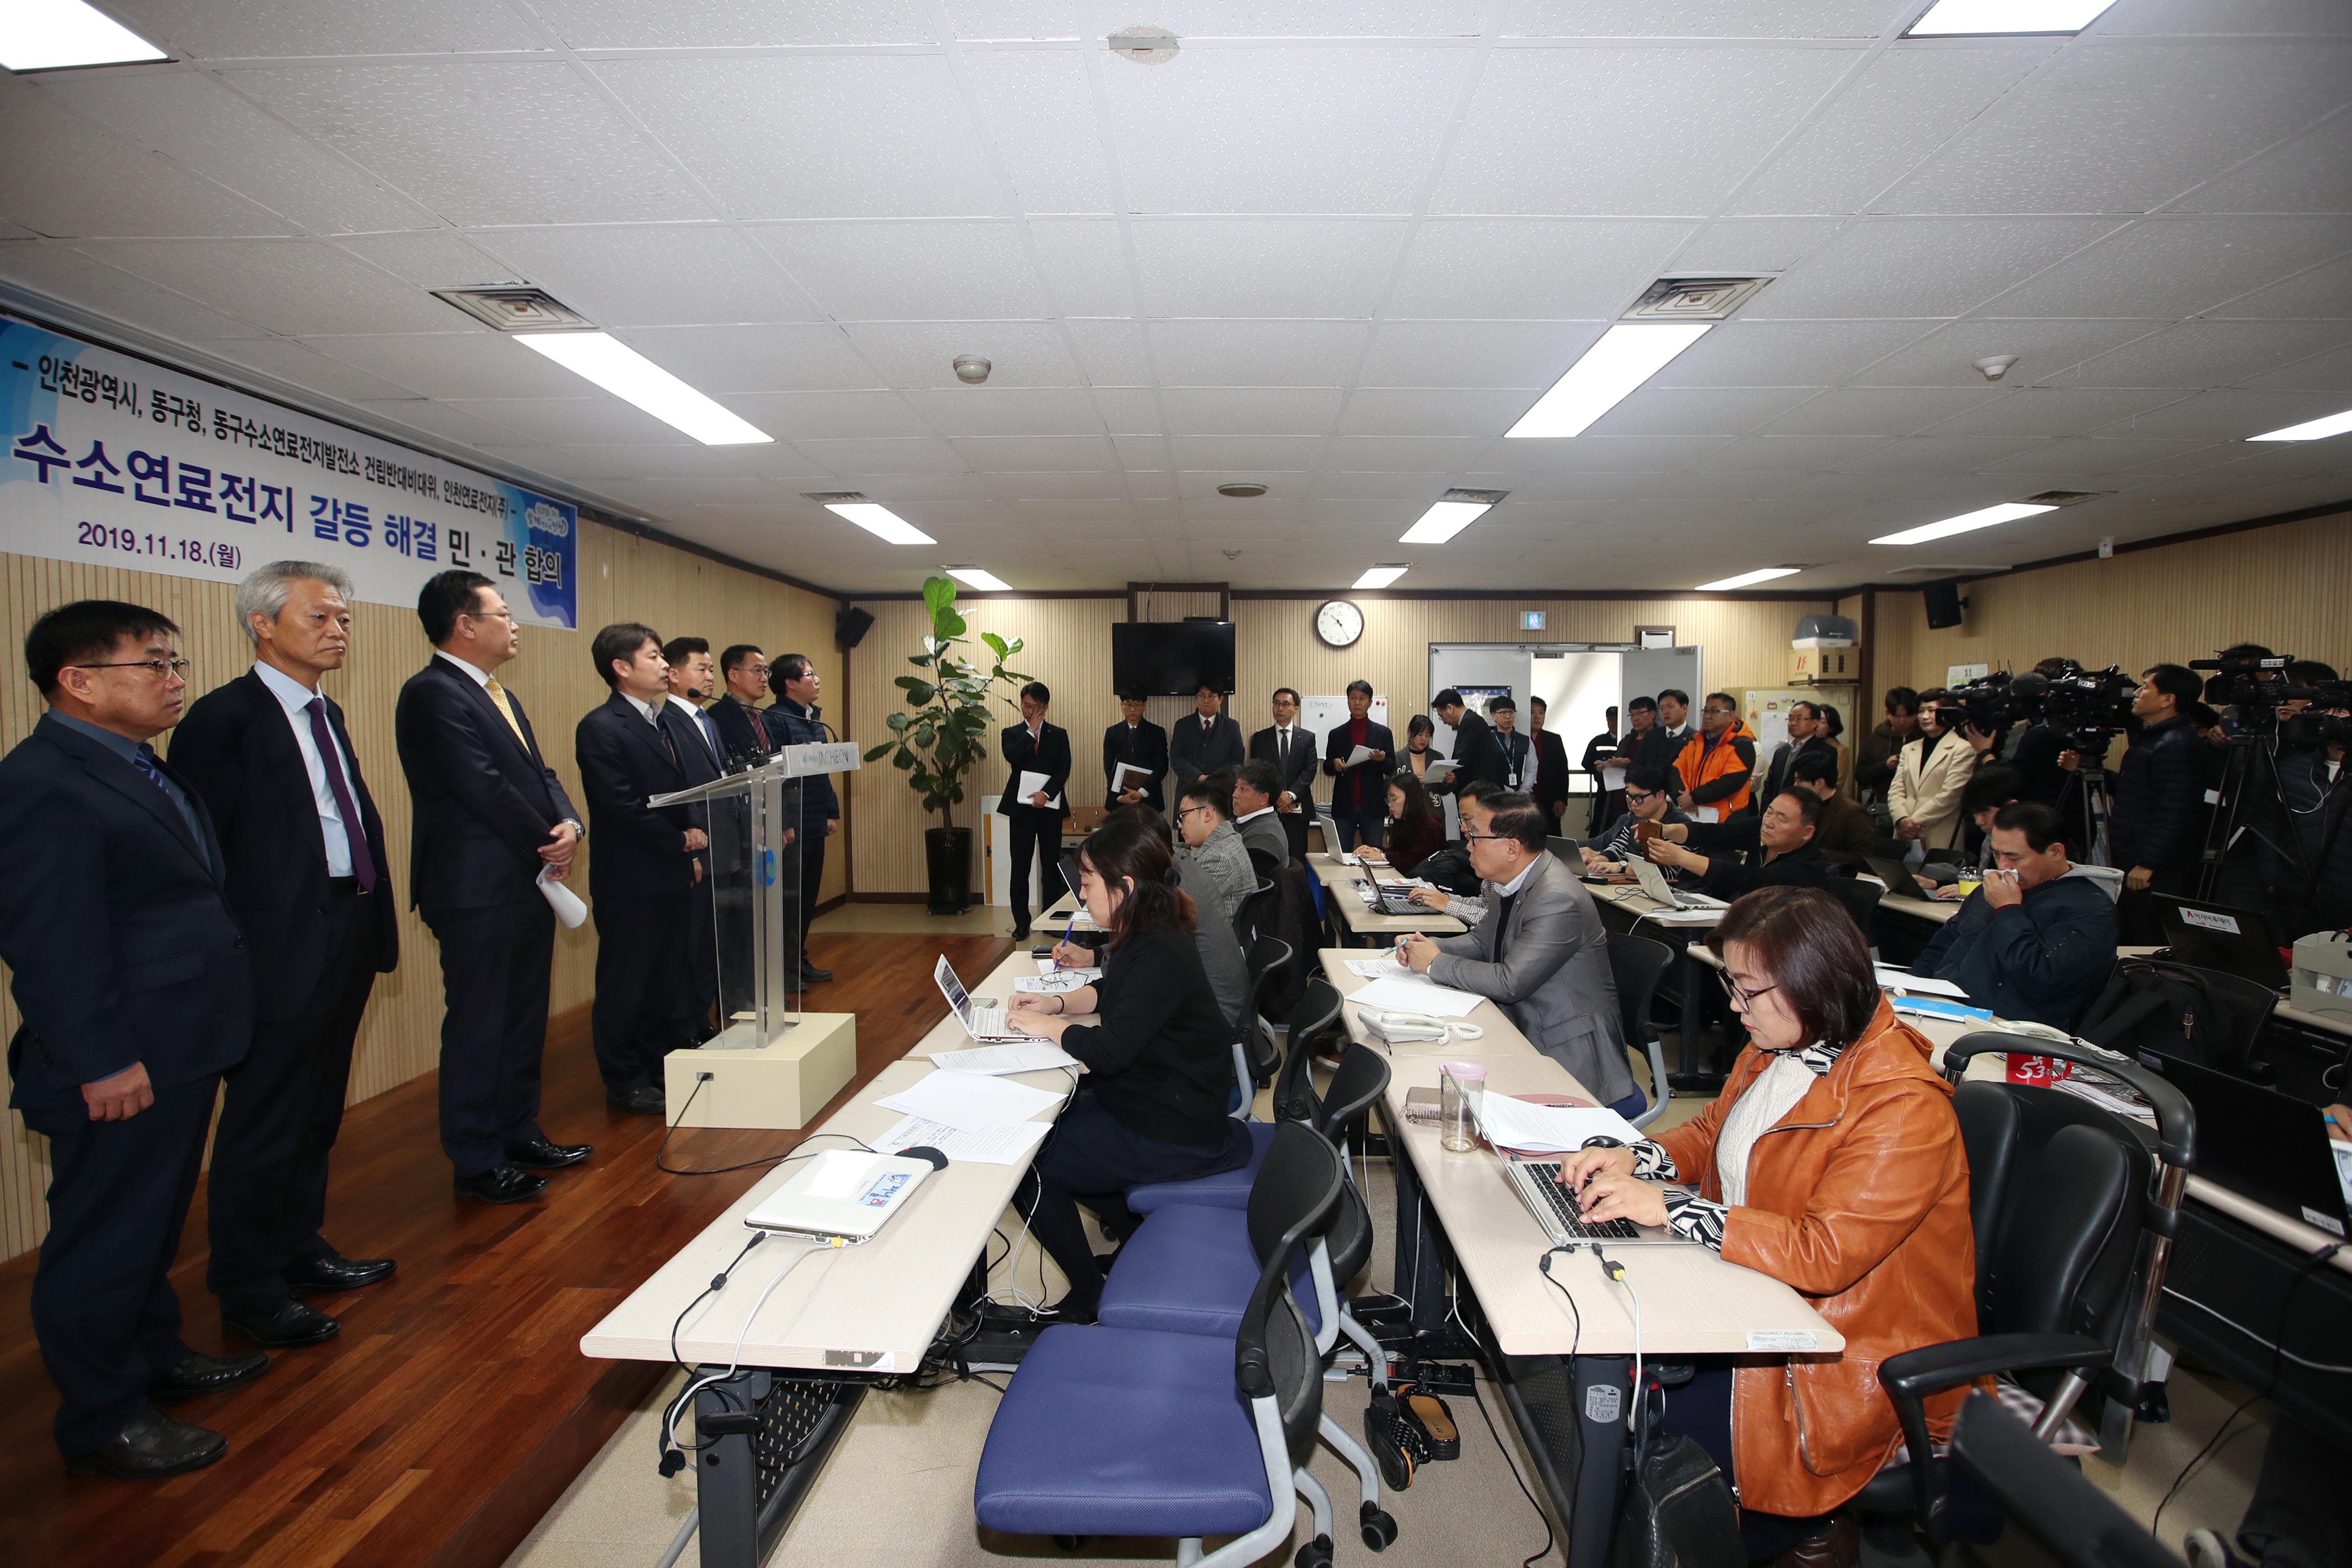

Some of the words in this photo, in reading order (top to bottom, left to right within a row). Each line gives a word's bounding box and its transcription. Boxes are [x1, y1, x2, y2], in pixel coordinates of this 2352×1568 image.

[38, 354, 143, 418] 인천광역시,
[151, 389, 206, 436] 동구청,
[214, 408, 360, 477] 동구수소연료전지발전소
[13, 425, 293, 534] 수소연료전지
[309, 494, 373, 547] 갈등
[384, 515, 437, 561] 해결
[524, 547, 562, 589] 합의
[78, 521, 242, 570] 2019.11.18.(월)
[1965, 668, 1972, 676] 11
[2077, 680, 2096, 688] KBS
[818, 749, 849, 765] INCHEON
[2194, 913, 2231, 926] 아시아투데이
